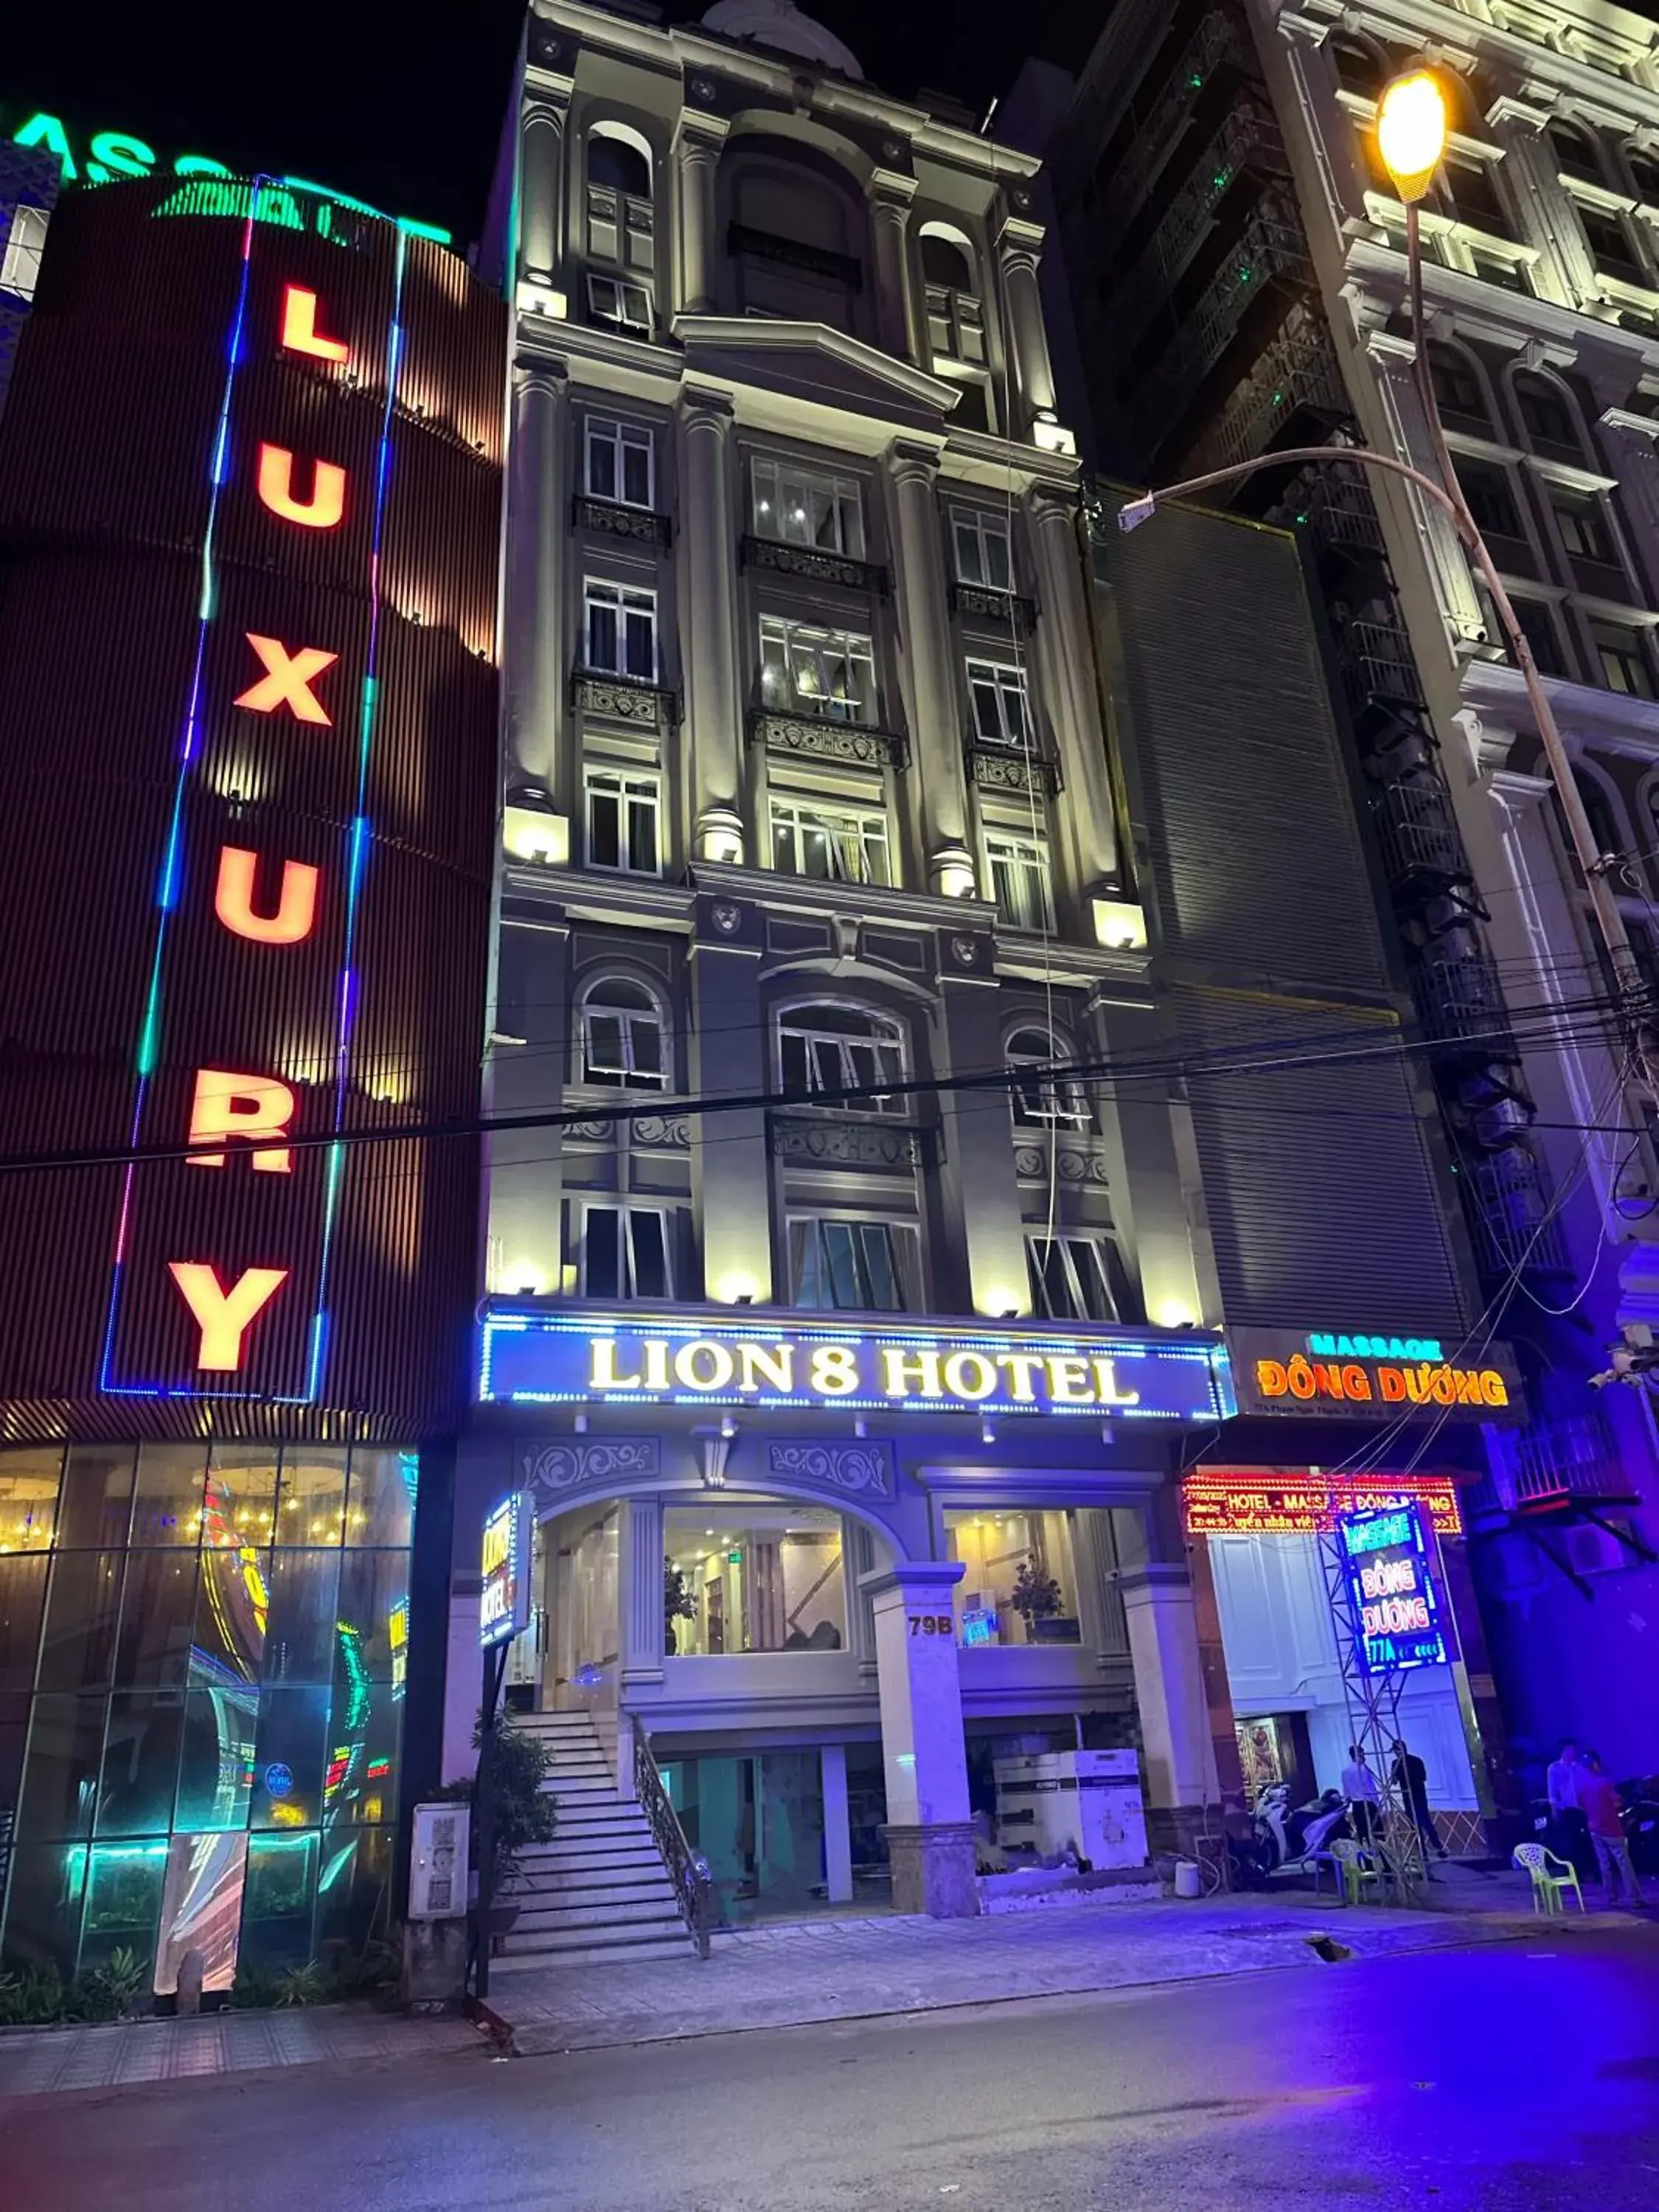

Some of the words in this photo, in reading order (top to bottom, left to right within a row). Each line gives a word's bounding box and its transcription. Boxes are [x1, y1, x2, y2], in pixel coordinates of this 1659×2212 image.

[168, 285, 349, 1373] LUXURY
[1308, 1334, 1444, 1361] MASSAGE
[588, 1338, 796, 1394] LION
[810, 1346, 860, 1396] 8
[882, 1349, 1141, 1406] HOTEL
[1256, 1354, 1372, 1401] ĐÔNG
[1377, 1363, 1509, 1406] DƯƠNG
[1228, 1493, 1272, 1510] HOTEL
[908, 1615, 953, 1636] 79B
